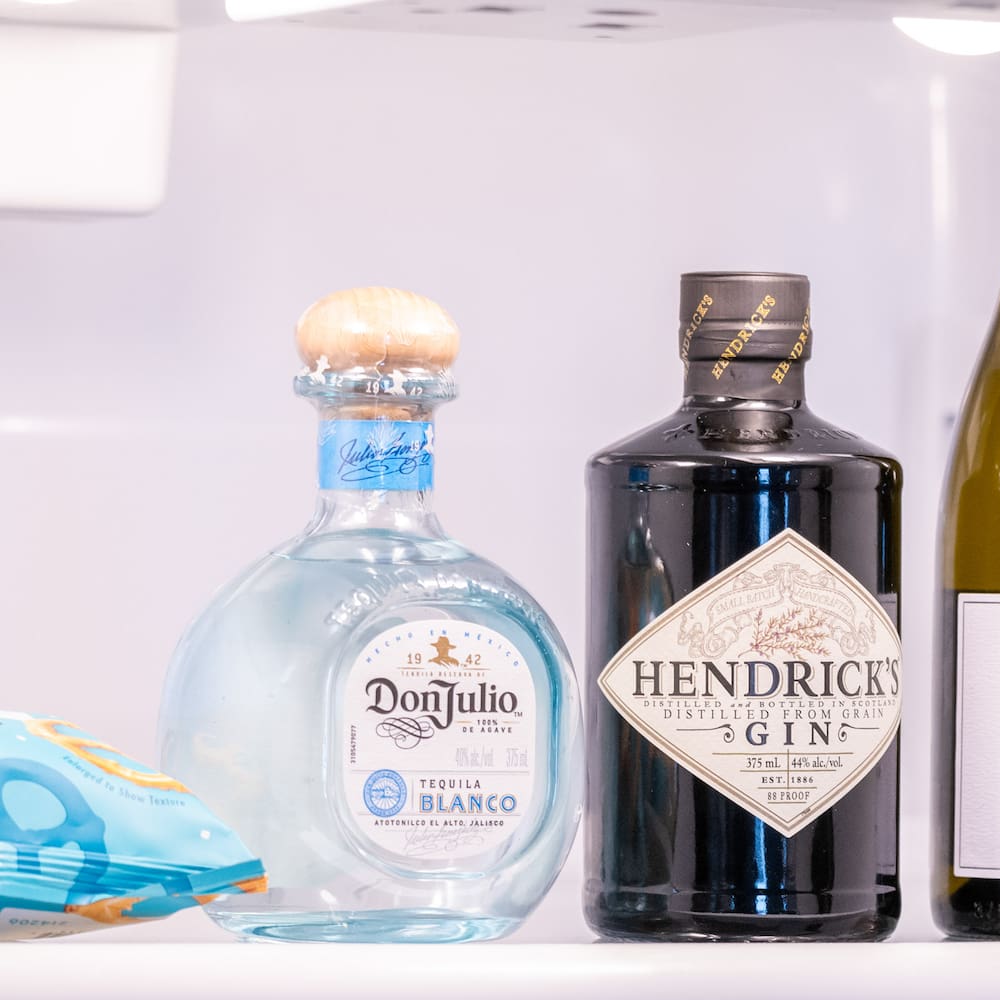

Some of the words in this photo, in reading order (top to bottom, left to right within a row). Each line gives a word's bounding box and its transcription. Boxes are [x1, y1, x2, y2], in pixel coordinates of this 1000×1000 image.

[712, 294, 776, 380] HENDRICK'S
[406, 652, 422, 665] 19
[465, 653, 481, 666] 42
[632, 658, 899, 699] HENDRICK'S
[730, 700, 752, 708] and
[832, 700, 845, 708] IN
[664, 709, 770, 720] DISTILLED
[783, 709, 832, 720] FROM
[842, 707, 884, 720] GRAIN
[746, 757, 762, 769] 375
[765, 757, 781, 769] mL
[791, 757, 811, 768] 44%
[62, 755, 104, 785] Enlarged
[105, 781, 115, 792] to
[119, 787, 145, 803] Show
[149, 794, 186, 808] Texture
[419, 779, 481, 790] TEQUILA
[761, 776, 786, 784] EST.
[791, 776, 814, 784] 1886
[767, 792, 777, 801] 88
[781, 791, 810, 801] PROOF
[419, 793, 517, 813] BLANCO
[374, 819, 426, 827] ATOTONILCO
[430, 819, 439, 827] EL
[469, 819, 504, 827] JALISCO
